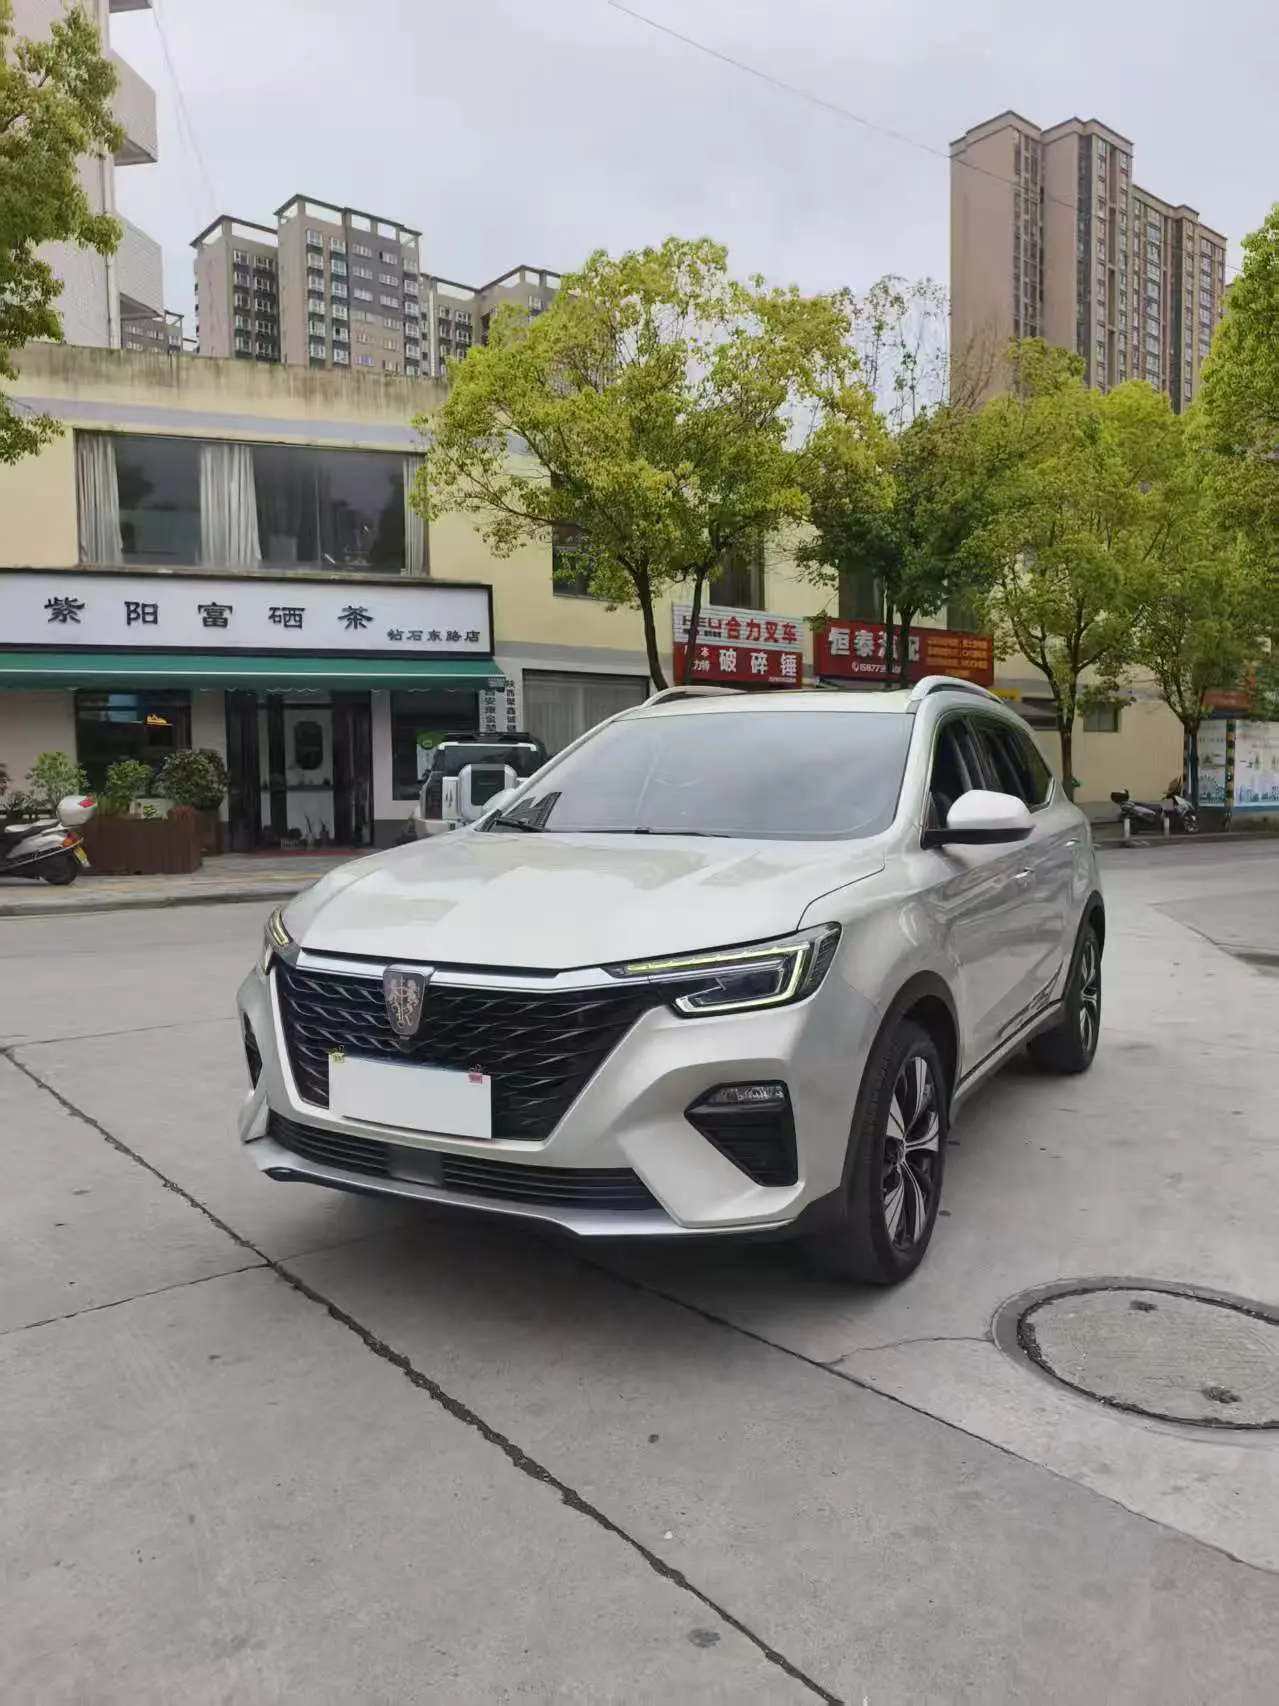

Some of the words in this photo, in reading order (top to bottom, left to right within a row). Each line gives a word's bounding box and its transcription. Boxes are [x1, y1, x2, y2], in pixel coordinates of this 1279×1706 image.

[44, 596, 375, 630] 紫阳富硒茶
